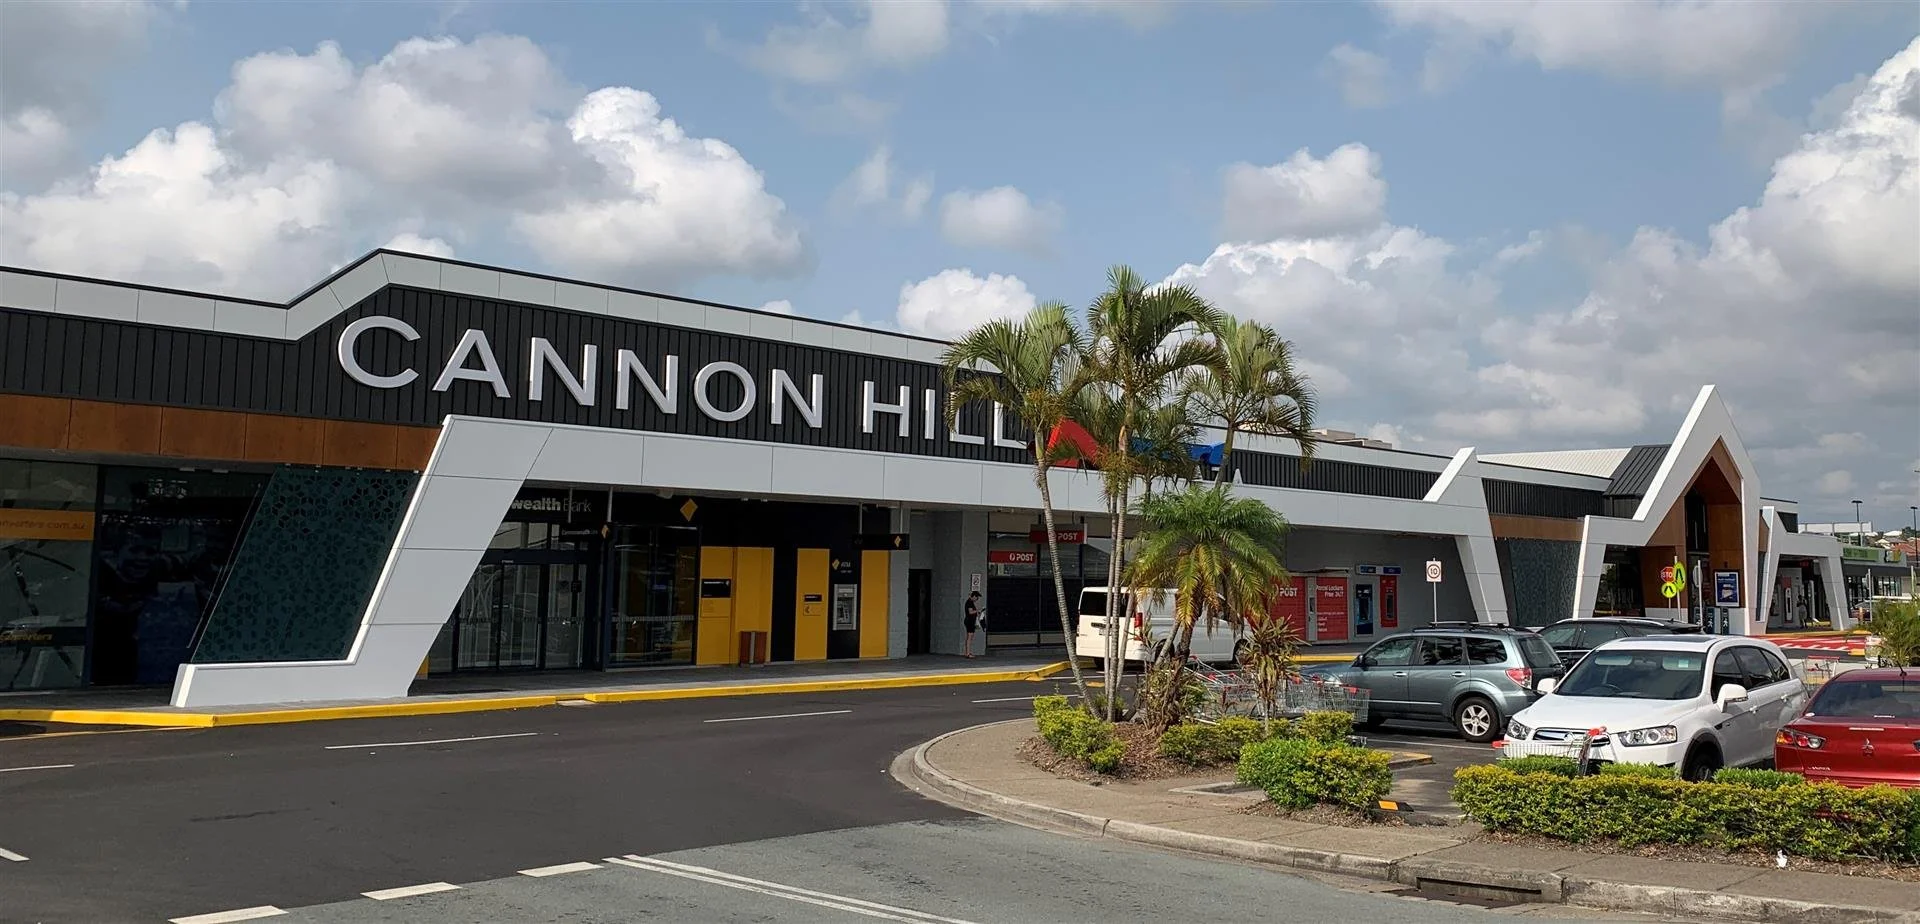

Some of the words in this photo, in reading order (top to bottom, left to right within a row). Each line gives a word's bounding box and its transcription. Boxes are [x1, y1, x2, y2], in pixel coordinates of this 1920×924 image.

[338, 315, 823, 428] CANNON
[862, 380, 1027, 449] HILL
[563, 497, 593, 512] Bank
[1057, 532, 1078, 540] POST
[1016, 553, 1034, 562] POST
[1430, 567, 1438, 576] 10
[1279, 587, 1298, 597] POST
